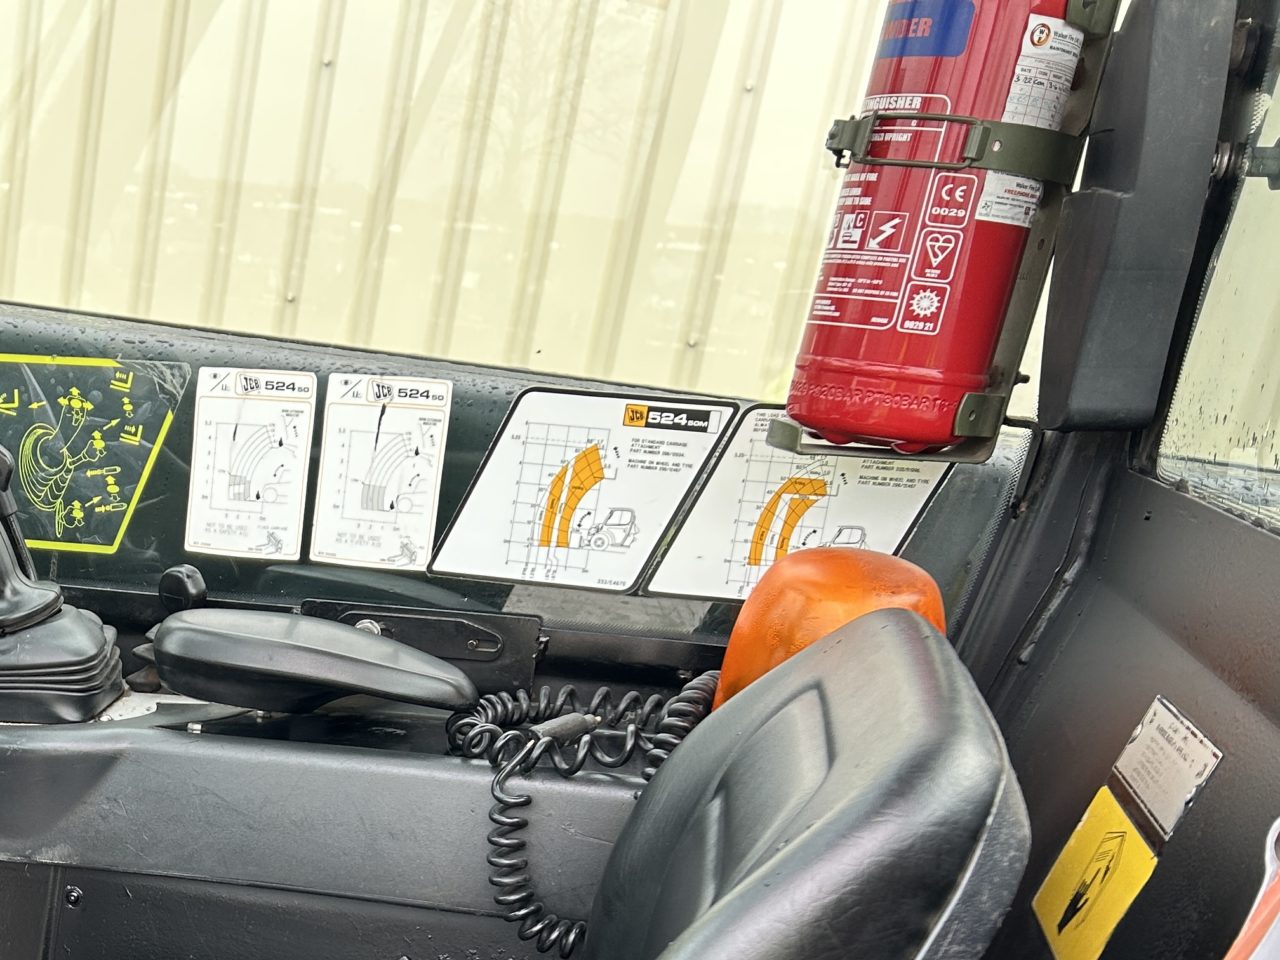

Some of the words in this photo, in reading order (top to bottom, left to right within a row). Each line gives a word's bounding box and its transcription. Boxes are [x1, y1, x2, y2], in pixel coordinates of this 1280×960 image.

[932, 207, 966, 218] 0029
[243, 376, 261, 391] JCB
[265, 381, 296, 392] 524
[376, 384, 393, 399] JCB
[398, 388, 430, 399] 524
[629, 409, 644, 421] JCB
